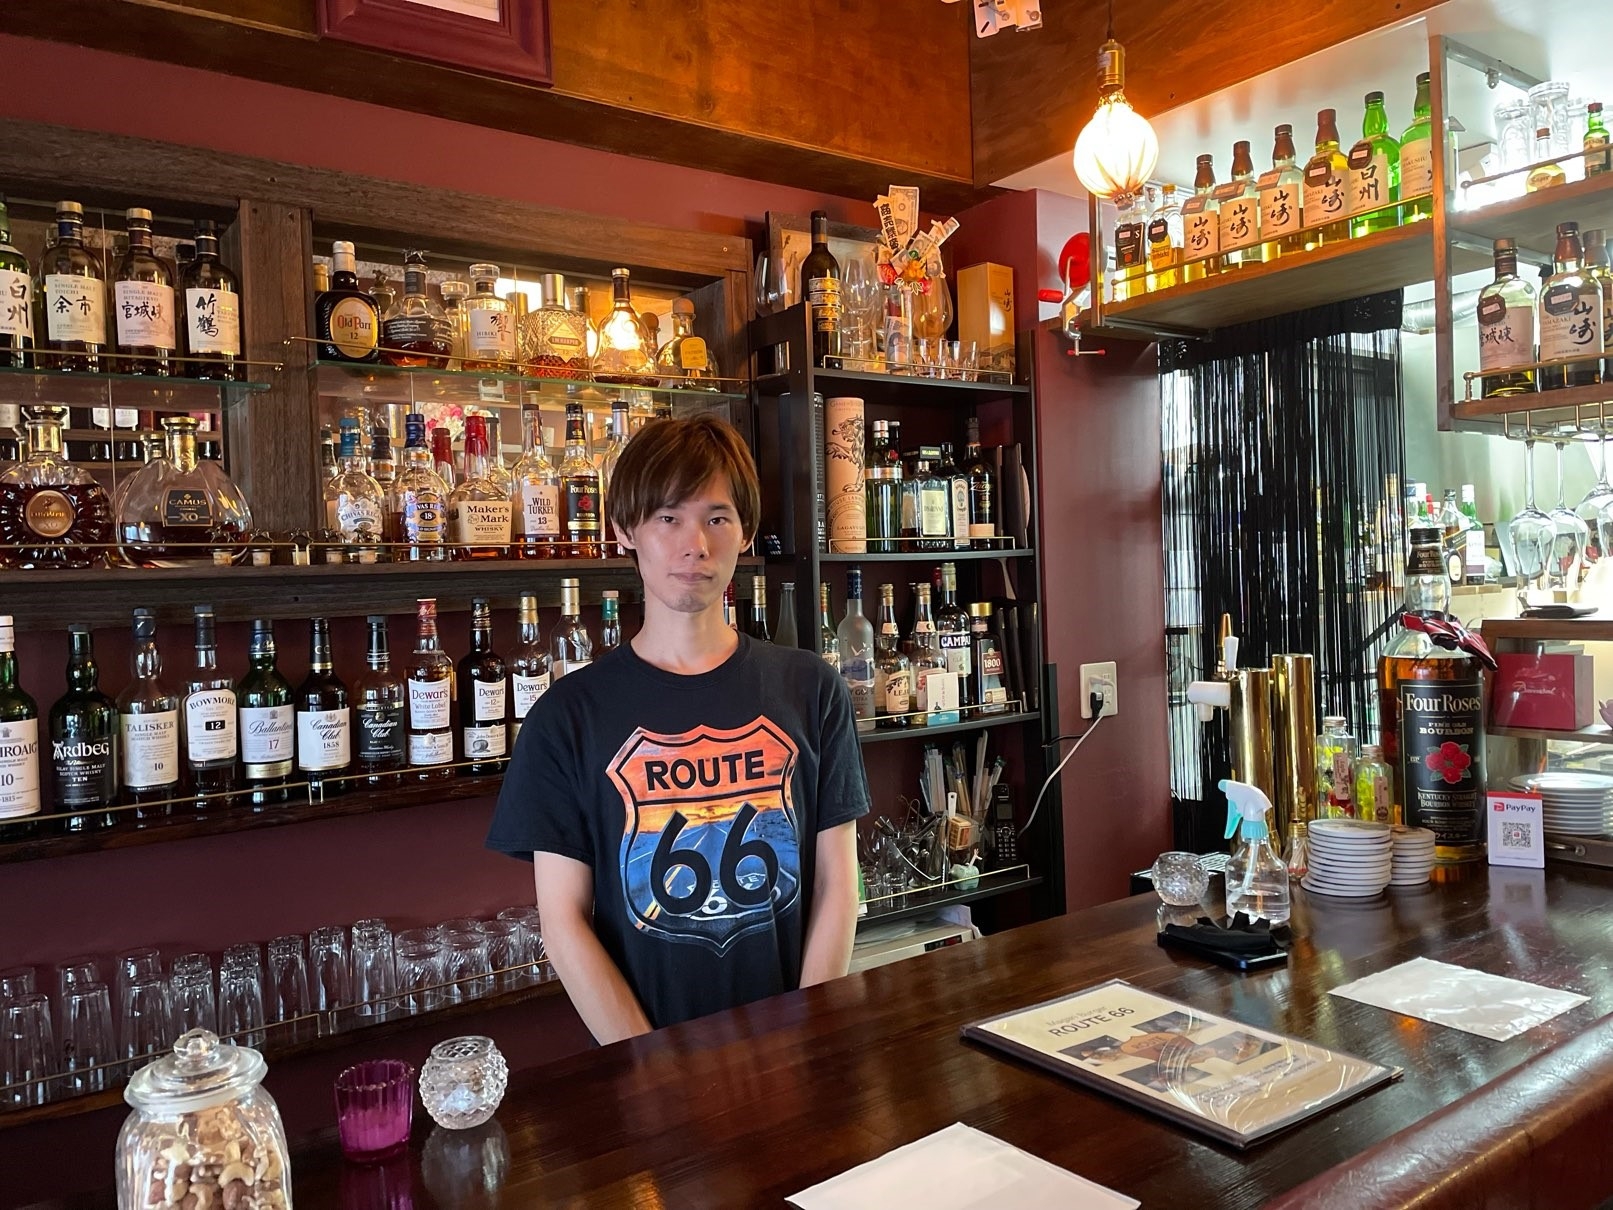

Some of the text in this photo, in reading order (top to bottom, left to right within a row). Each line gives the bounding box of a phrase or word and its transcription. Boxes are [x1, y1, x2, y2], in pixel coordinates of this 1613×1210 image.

[53, 295, 95, 316] 余市
[350, 331, 359, 340] 12
[531, 497, 551, 506] WILD
[467, 505, 510, 514] Maker's
[527, 505, 555, 515] TURKEY
[180, 512, 199, 522] XO
[424, 512, 433, 520] 18
[480, 514, 510, 523] Mark
[537, 516, 548, 525] 13
[983, 658, 1001, 669] 1800
[517, 682, 548, 692] Dewar's
[411, 688, 449, 700] Dewar's
[529, 694, 537, 702] 15
[189, 695, 236, 710] BOWMORE
[415, 701, 447, 710] White Label
[1405, 692, 1481, 713] Four Roses
[125, 721, 175, 733] TALISKER
[209, 721, 222, 730] 12
[310, 719, 347, 731] Canadian
[362, 718, 398, 729] Canadian
[320, 729, 342, 741] Club
[370, 727, 392, 738] Club
[1419, 727, 1474, 736] BOURBON
[268, 739, 280, 750] 17
[323, 741, 340, 750] 1858
[154, 762, 164, 771] 10
[644, 749, 766, 792] ROUTE
[1, 773, 14, 787] 10
[1417, 791, 1451, 801] KENTUCKY
[1420, 799, 1451, 808] BOURBON
[1506, 803, 1536, 813] PayPay
[650, 800, 780, 916] 66
[1048, 1007, 1136, 1037] ROUTE 66
